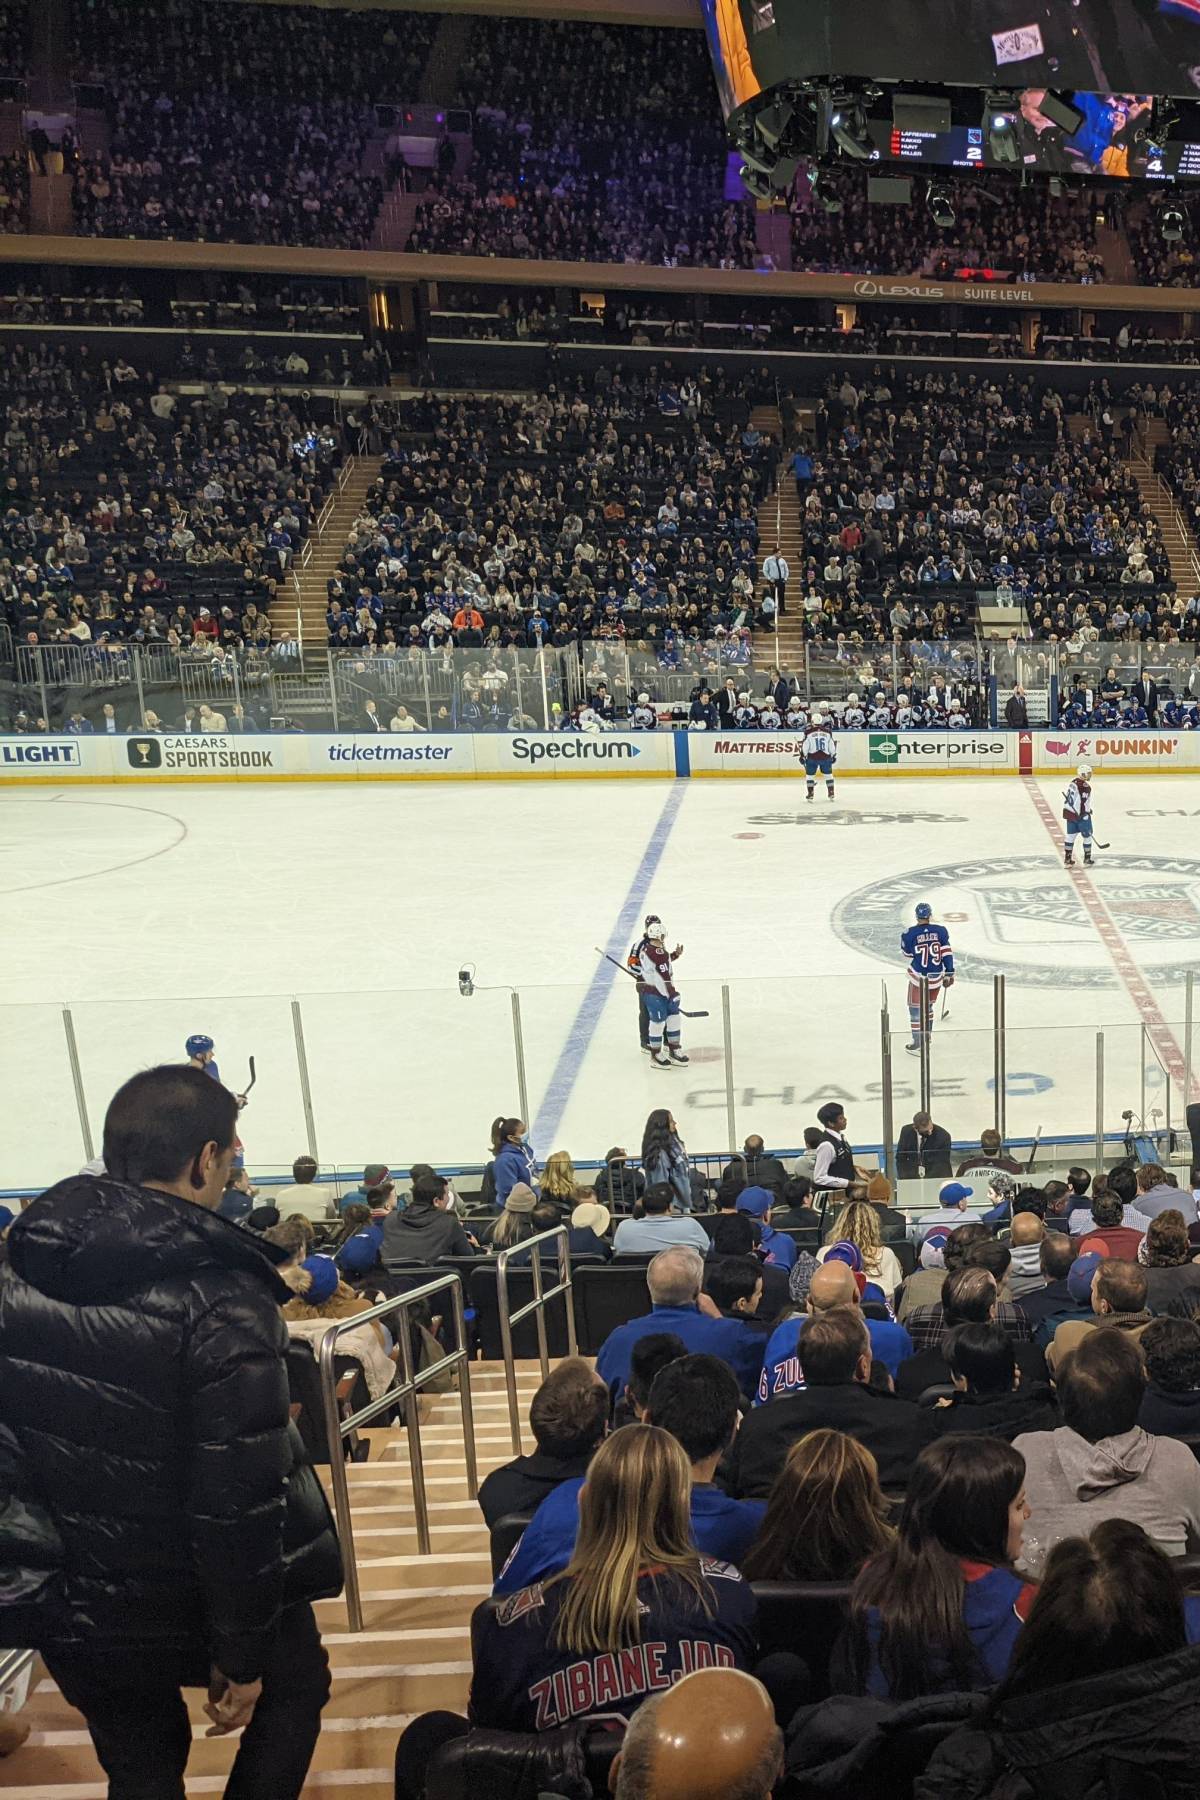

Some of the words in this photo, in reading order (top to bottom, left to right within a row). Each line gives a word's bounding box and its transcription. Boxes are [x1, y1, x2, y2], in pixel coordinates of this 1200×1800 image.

[966, 147, 982, 160] 2
[1147, 160, 1163, 172] 4
[879, 286, 944, 297] LEXUS
[964, 289, 997, 300] SUITE
[1000, 290, 1034, 301] LEVEL
[164, 738, 228, 749] CAESARS
[512, 737, 632, 763] Spectrum
[714, 741, 794, 754] MATTRESS
[815, 738, 826, 752] 16
[1095, 739, 1178, 755] DUNKIN'
[4, 746, 74, 763] LIGHT
[166, 751, 273, 768] SPORTSBOOK
[328, 743, 453, 761] ticketmaster
[855, 878, 924, 912] NEW
[920, 858, 1050, 881] YORK
[989, 890, 1070, 902] NEW
[1100, 888, 1189, 900] YORK
[914, 941, 942, 968] 79
[659, 962, 669, 973] 91
[684, 1077, 969, 1109] CHASE
[758, 1367, 769, 1402] 6
[528, 1639, 736, 1732] ZIBANEJAD
